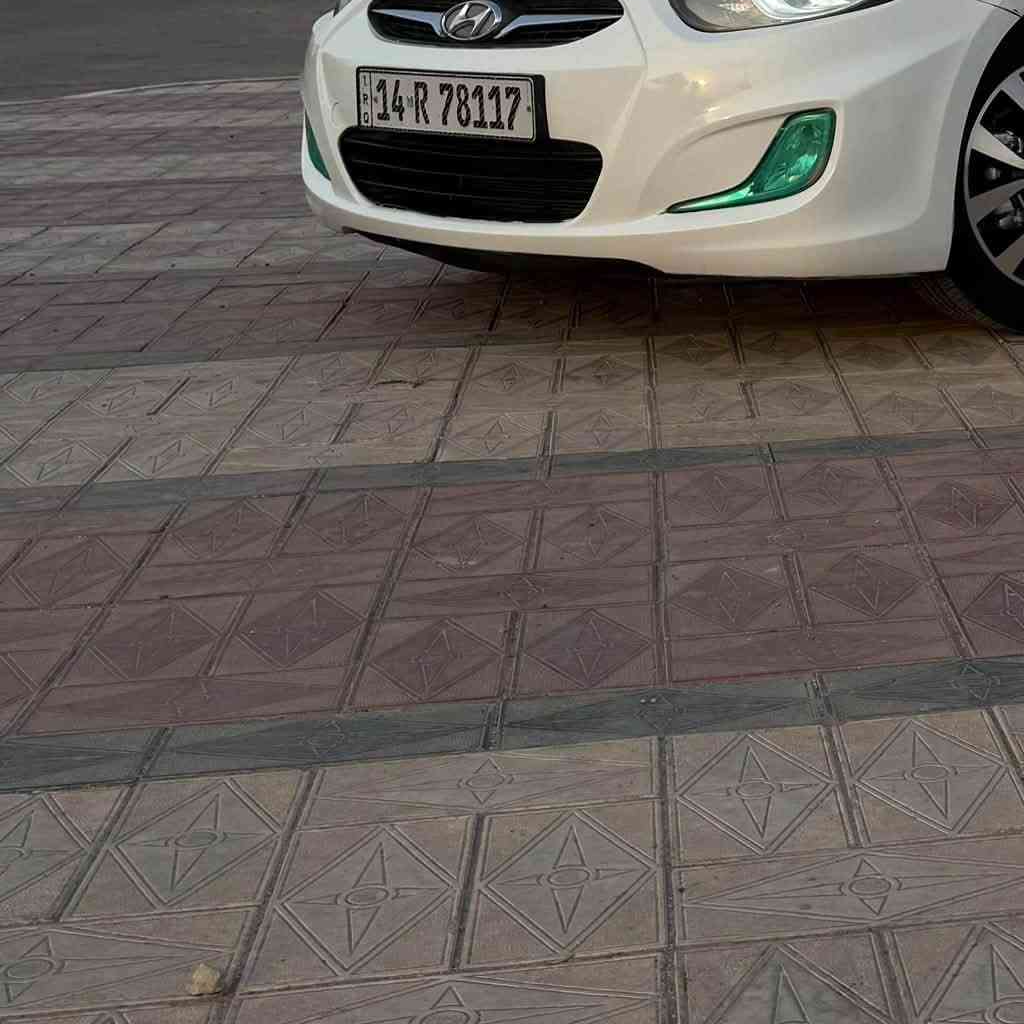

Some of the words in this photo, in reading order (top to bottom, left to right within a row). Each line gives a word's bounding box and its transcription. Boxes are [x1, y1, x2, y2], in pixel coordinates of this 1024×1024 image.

[376, 79, 404, 121] 14
[414, 81, 430, 124] R
[439, 82, 521, 130] 78117
